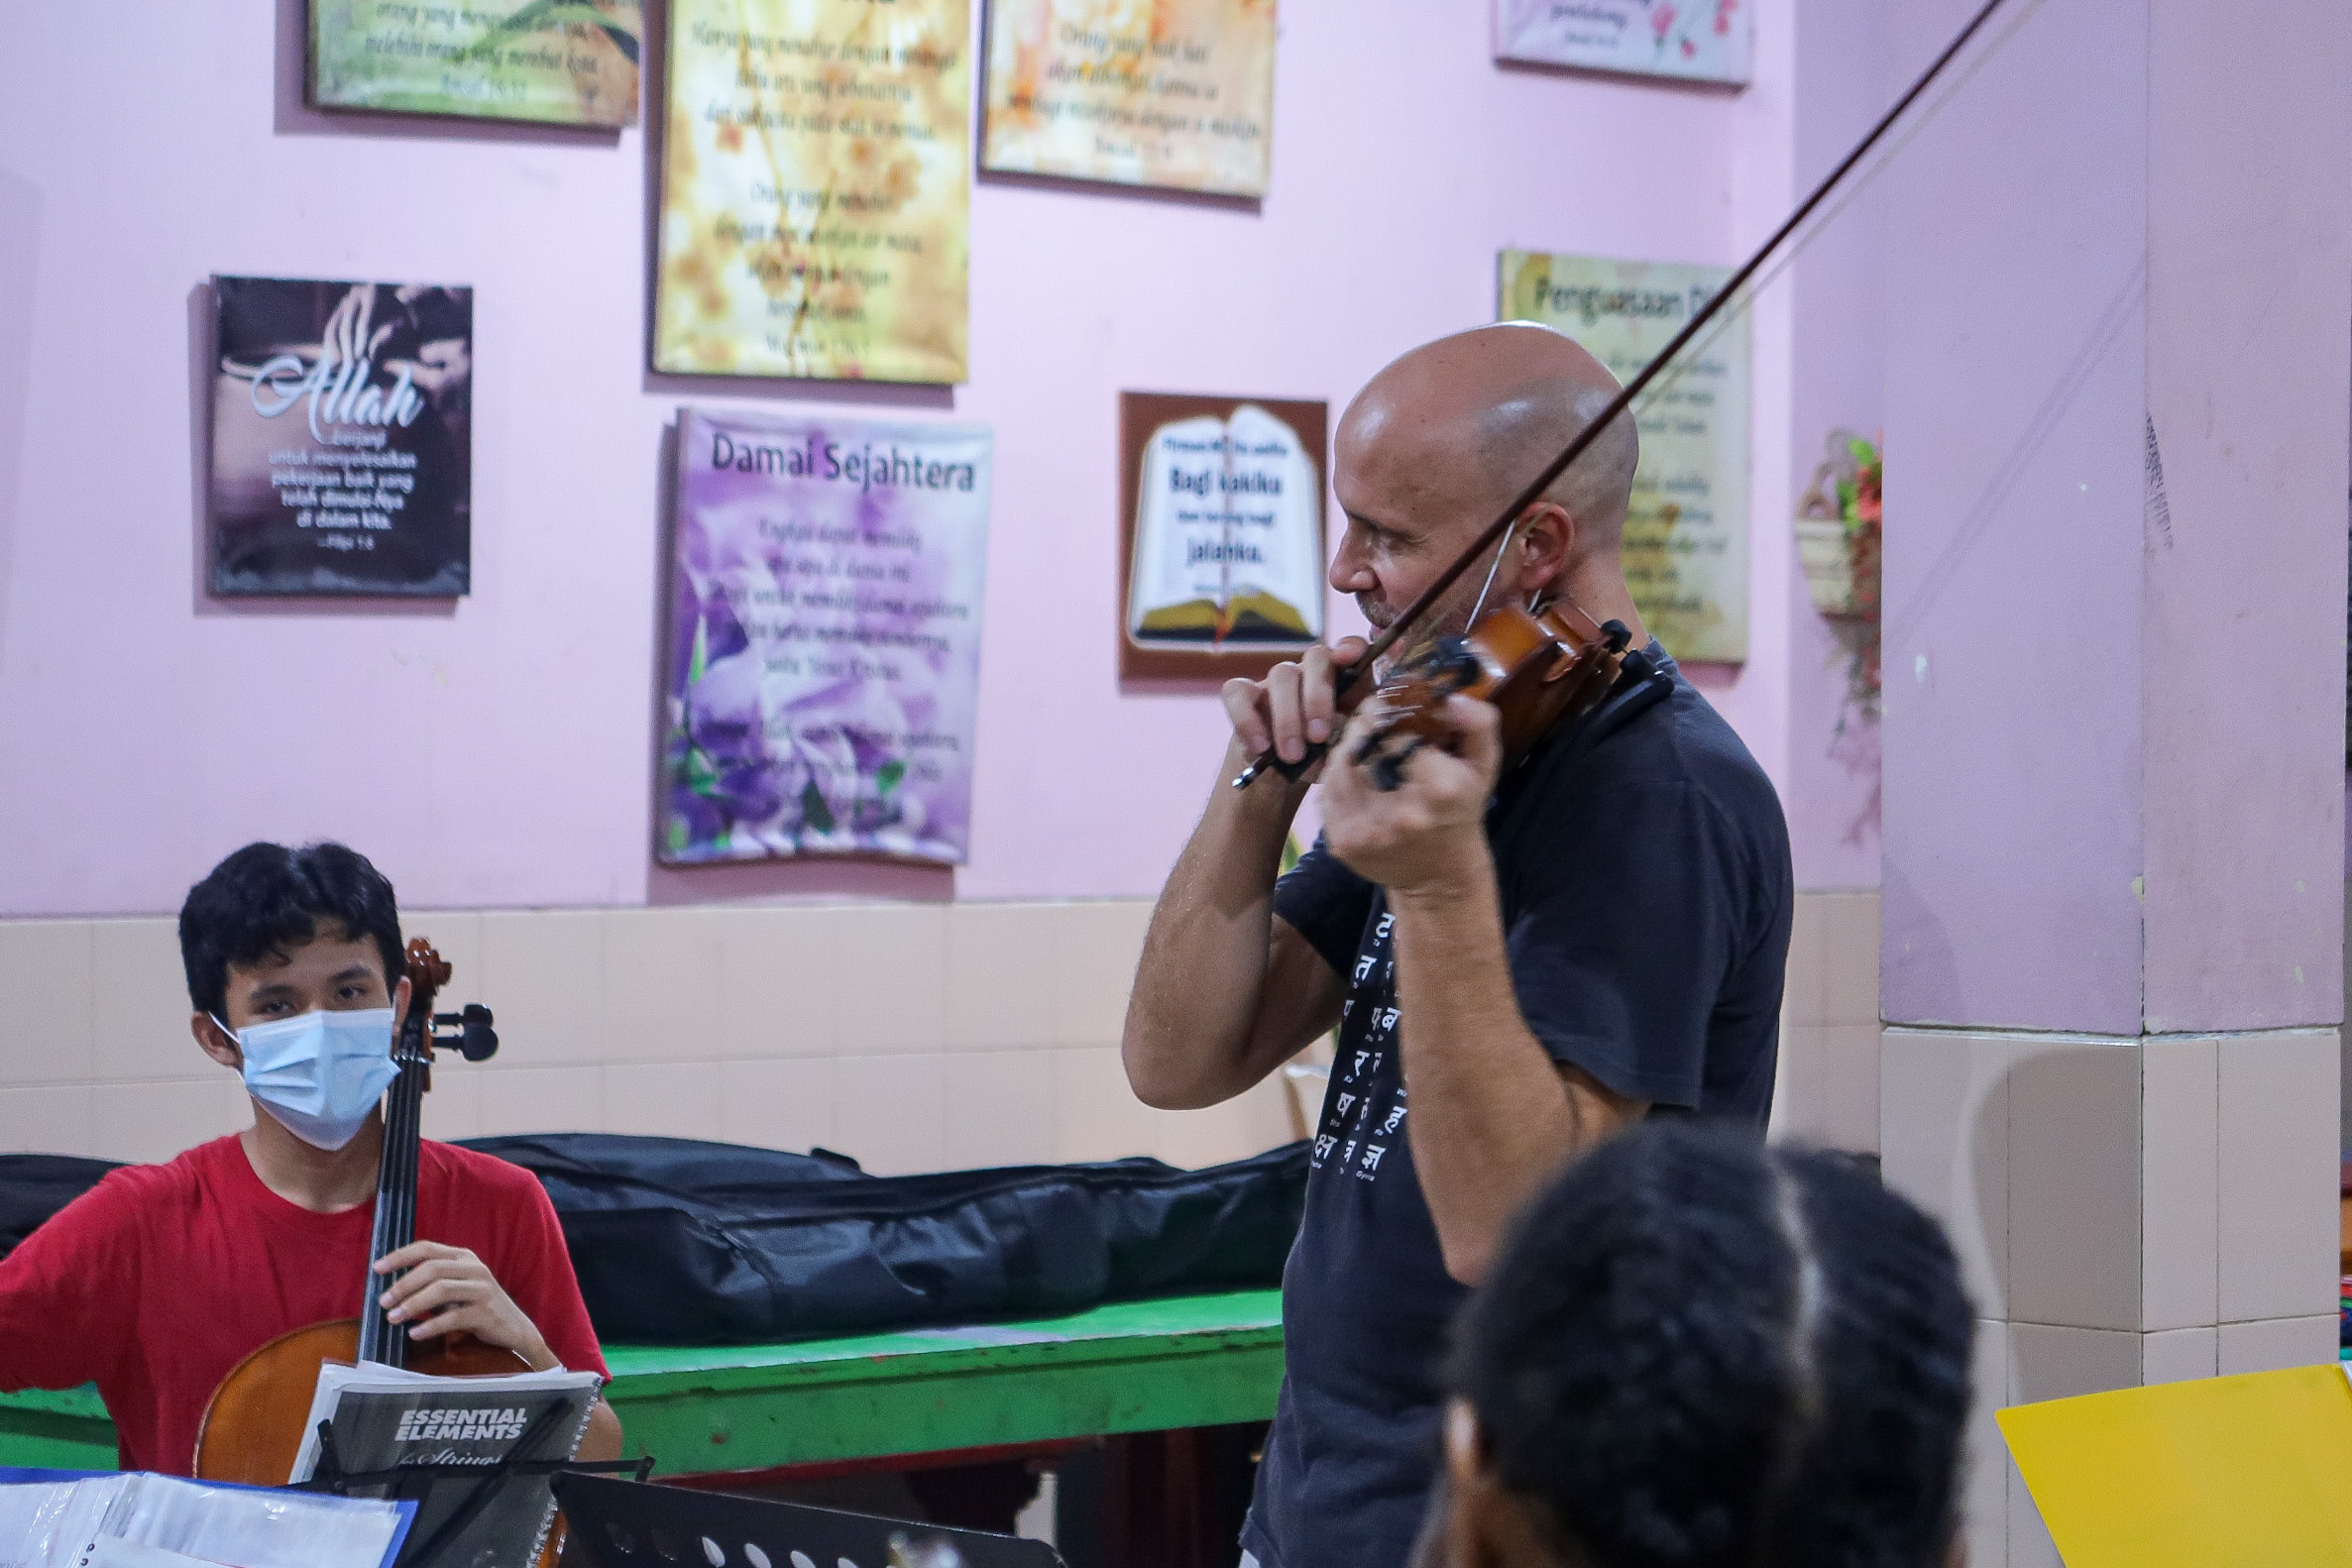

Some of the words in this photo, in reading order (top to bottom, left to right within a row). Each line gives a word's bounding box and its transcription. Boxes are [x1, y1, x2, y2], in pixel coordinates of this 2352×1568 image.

[1535, 277, 1684, 327] Penguasaan
[252, 350, 425, 444] Allah
[712, 432, 814, 478] Damai
[824, 442, 976, 493] Sejahtera
[1170, 466, 1210, 500] Bagi
[1219, 469, 1283, 496] kakiku
[394, 1424, 524, 1442] ELEMENTS
[399, 1407, 528, 1425] ESSENTIAL
